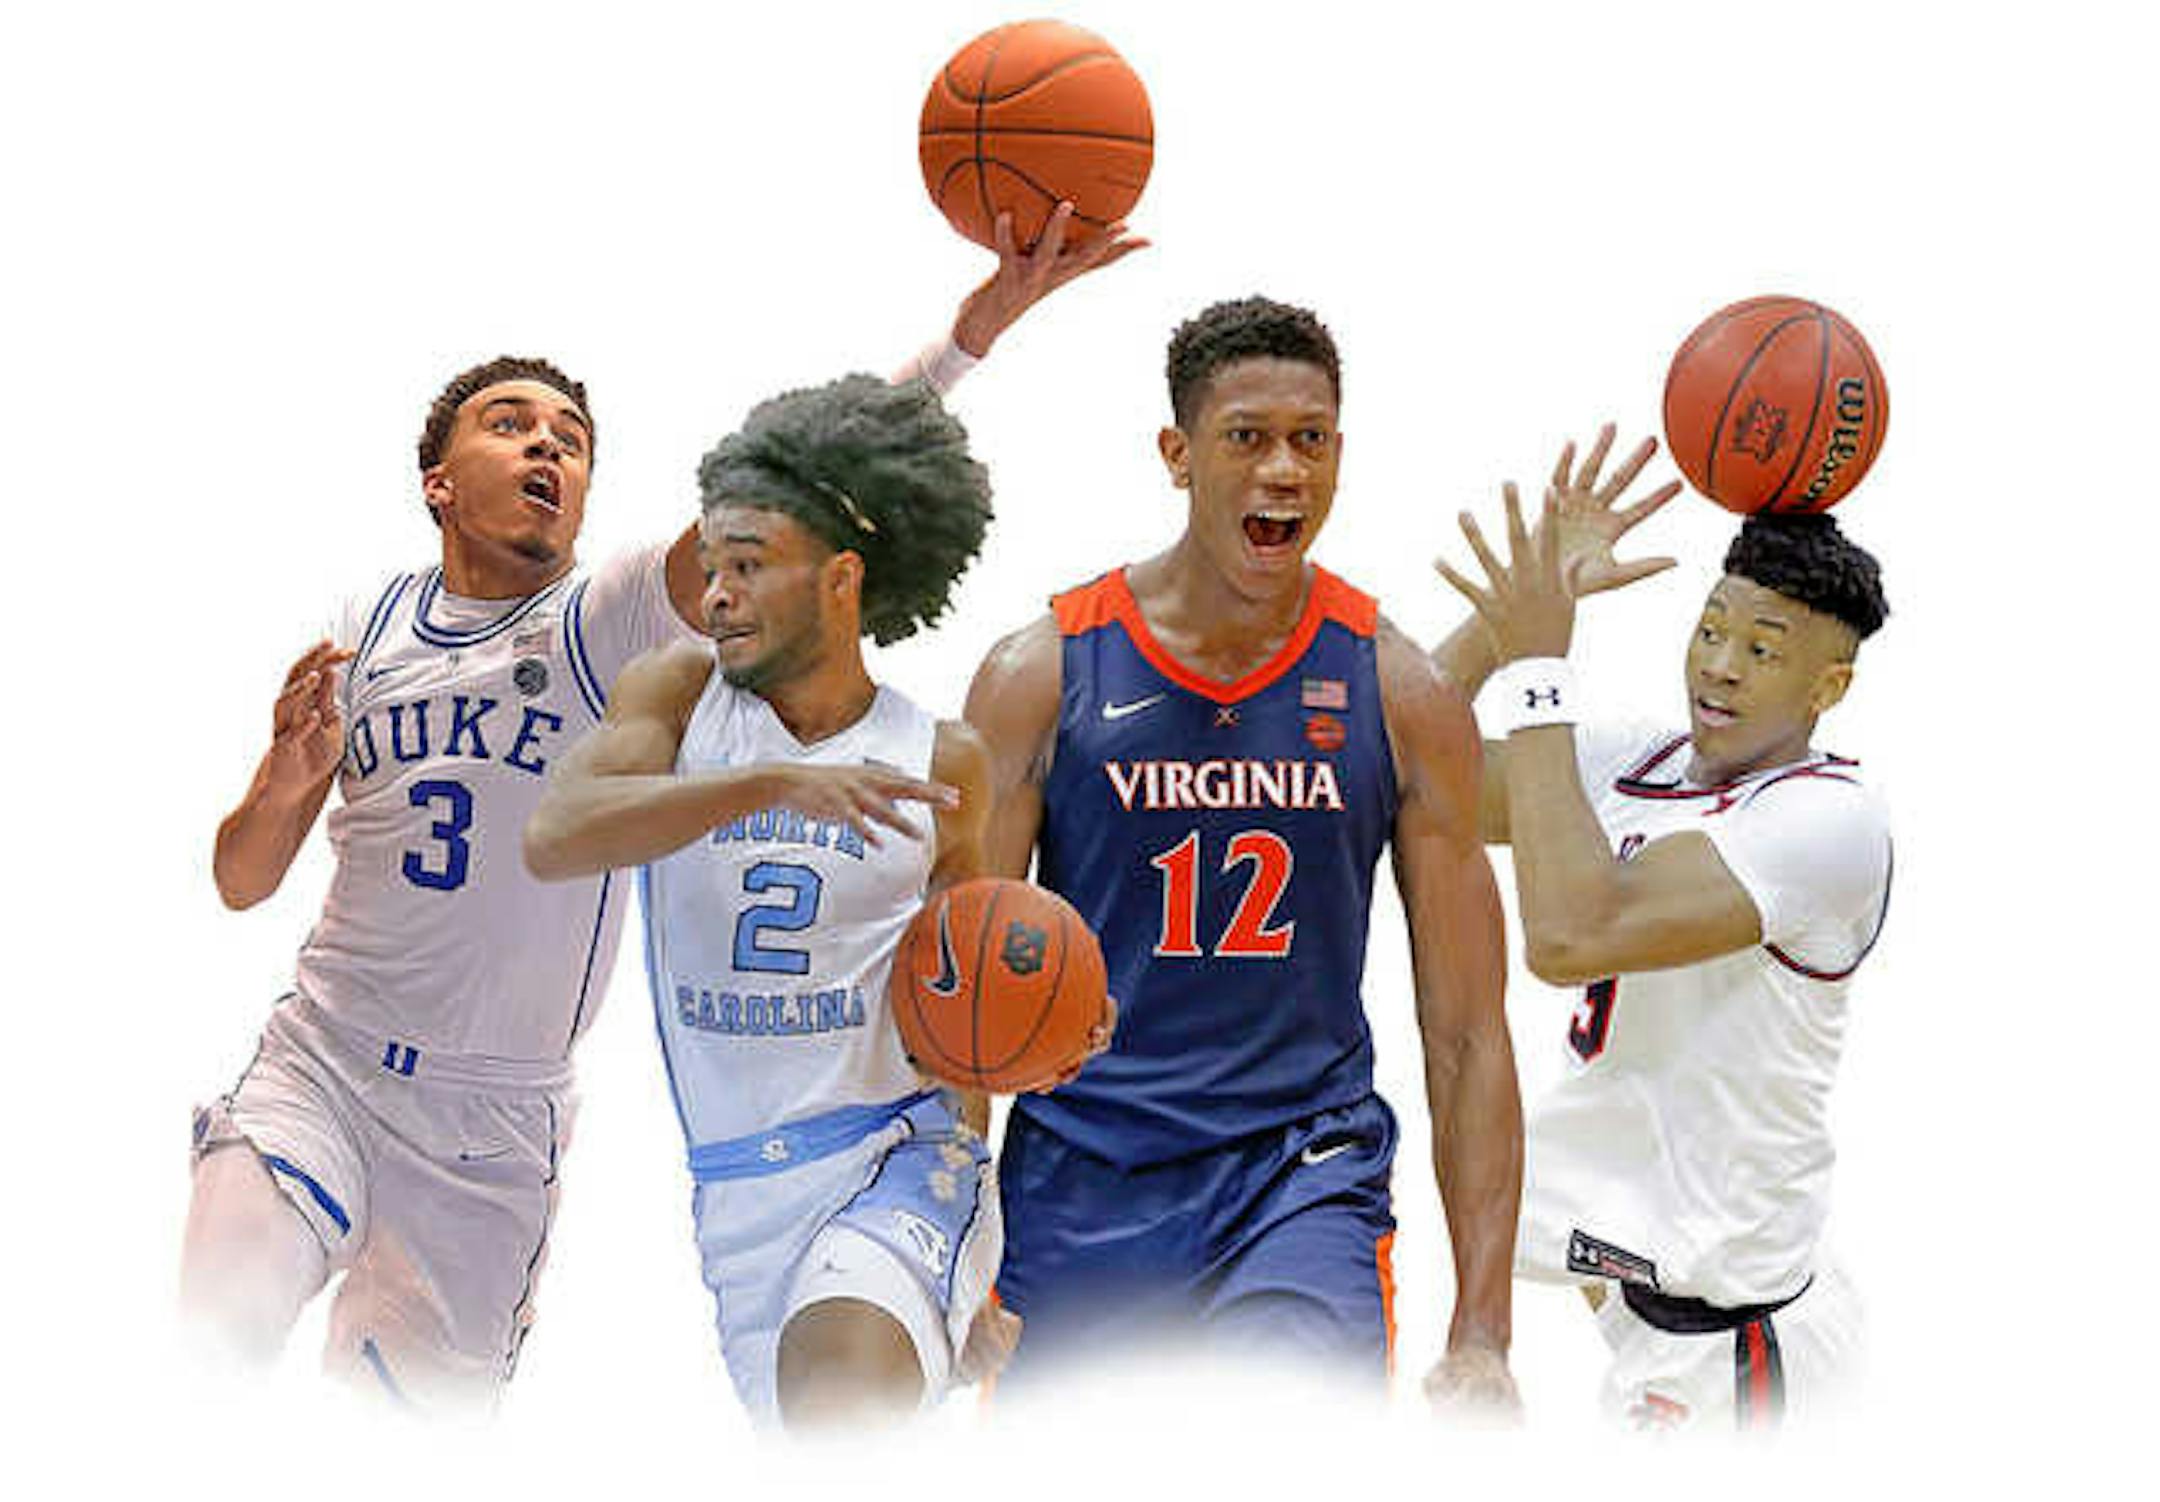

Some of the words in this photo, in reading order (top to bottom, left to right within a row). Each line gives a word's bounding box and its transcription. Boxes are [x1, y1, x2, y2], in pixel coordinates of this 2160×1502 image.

[350, 697, 562, 778] DUKE
[1105, 760, 1345, 811] VIRGINIA
[402, 780, 473, 890] 3
[732, 861, 823, 975] 2
[1150, 829, 1294, 958] 12
